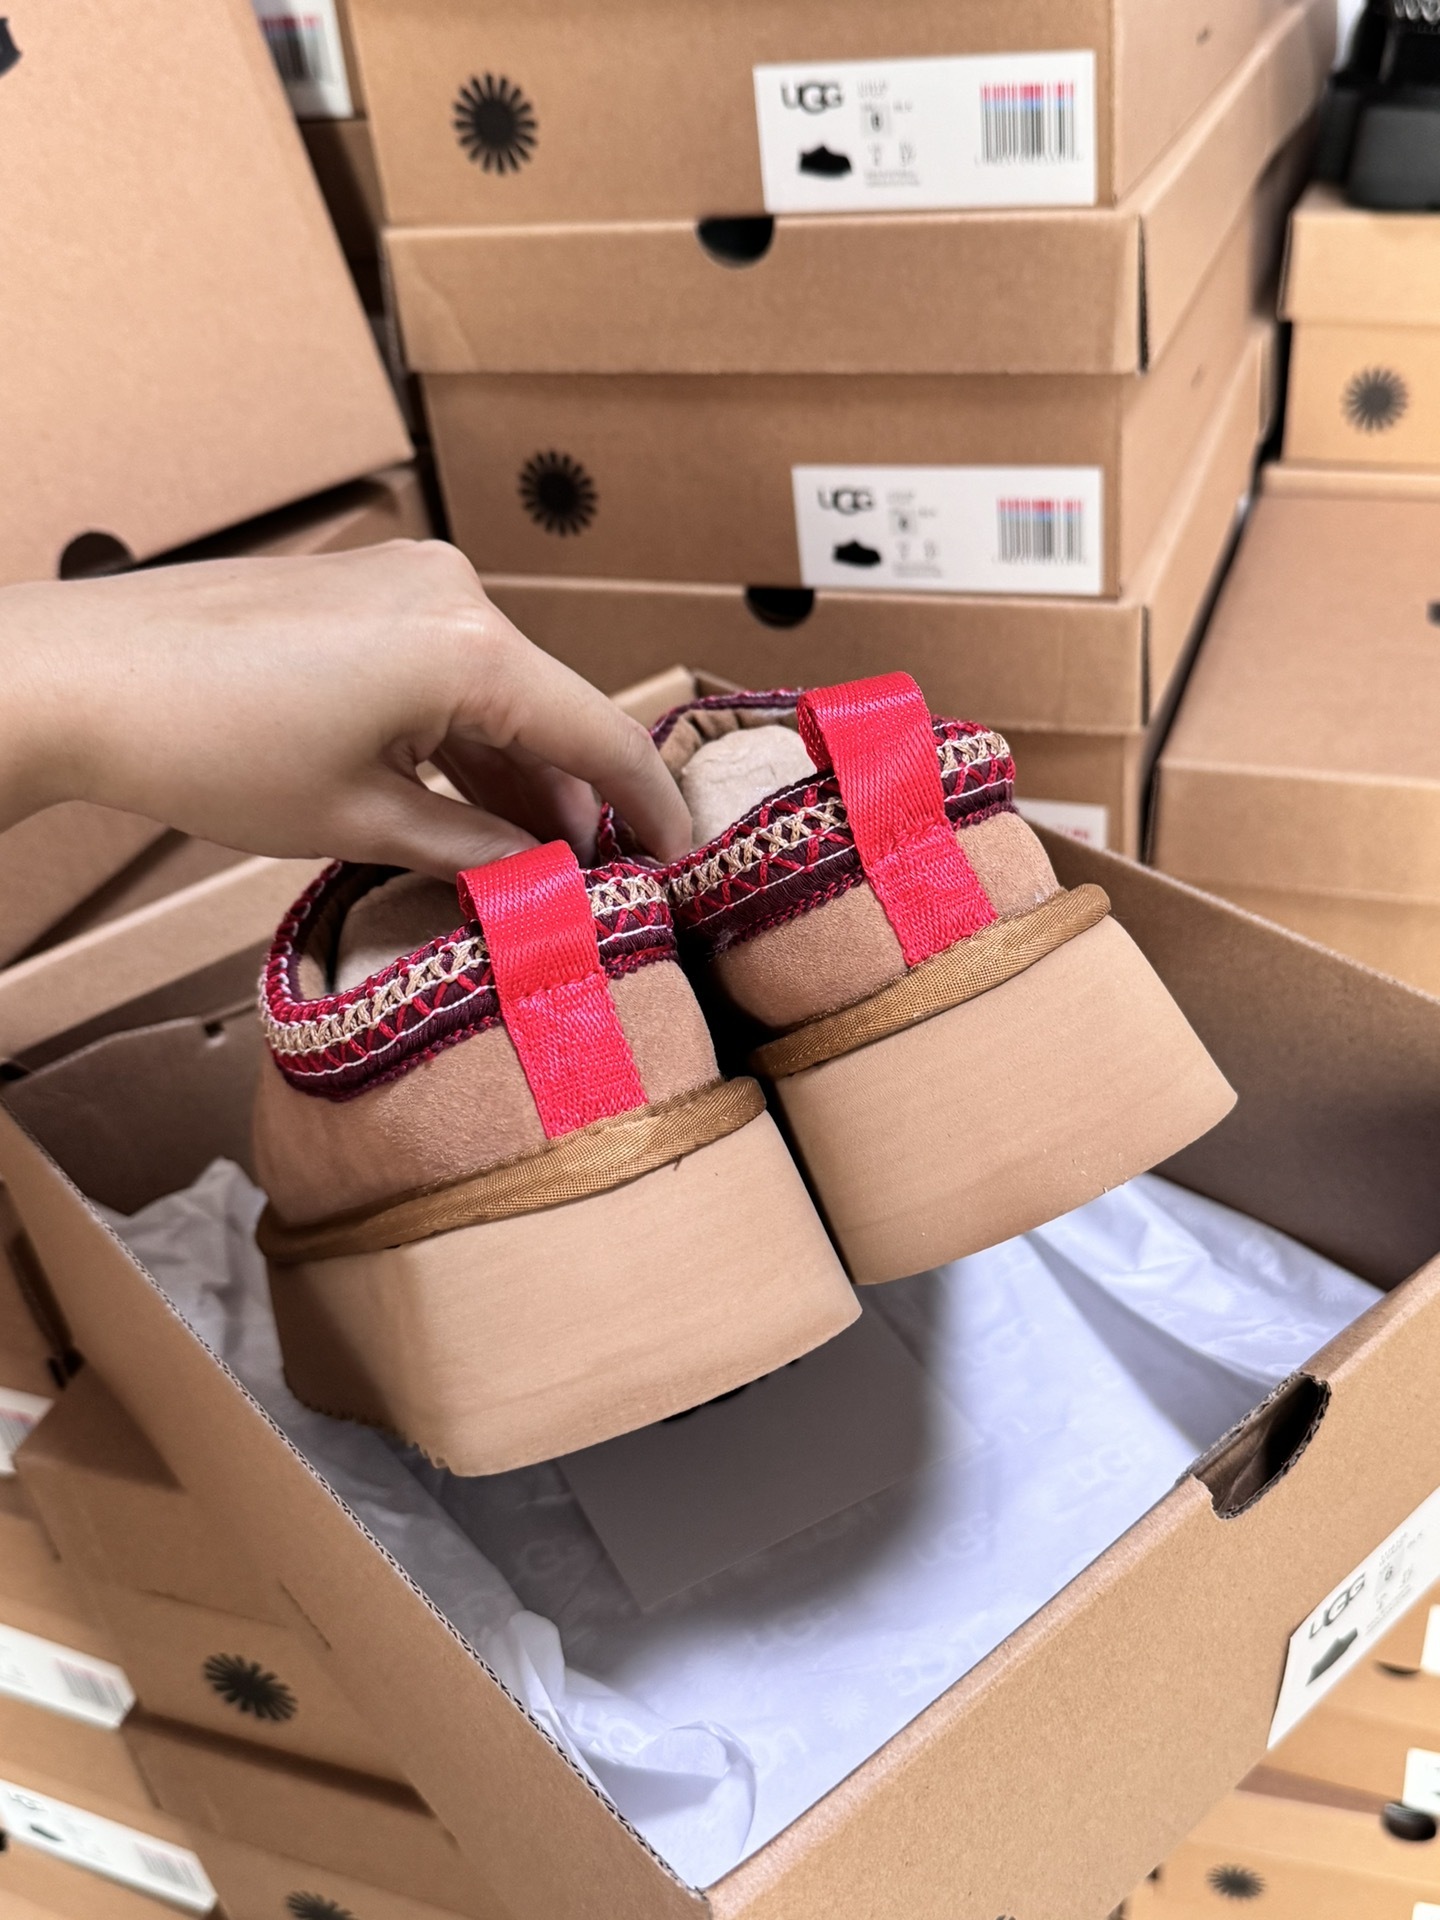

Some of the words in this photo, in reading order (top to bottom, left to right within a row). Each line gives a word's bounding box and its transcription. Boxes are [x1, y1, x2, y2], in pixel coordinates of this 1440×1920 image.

[781, 81, 843, 114] UGG
[817, 487, 873, 515] UGG
[1309, 1573, 1366, 1639] UGG
